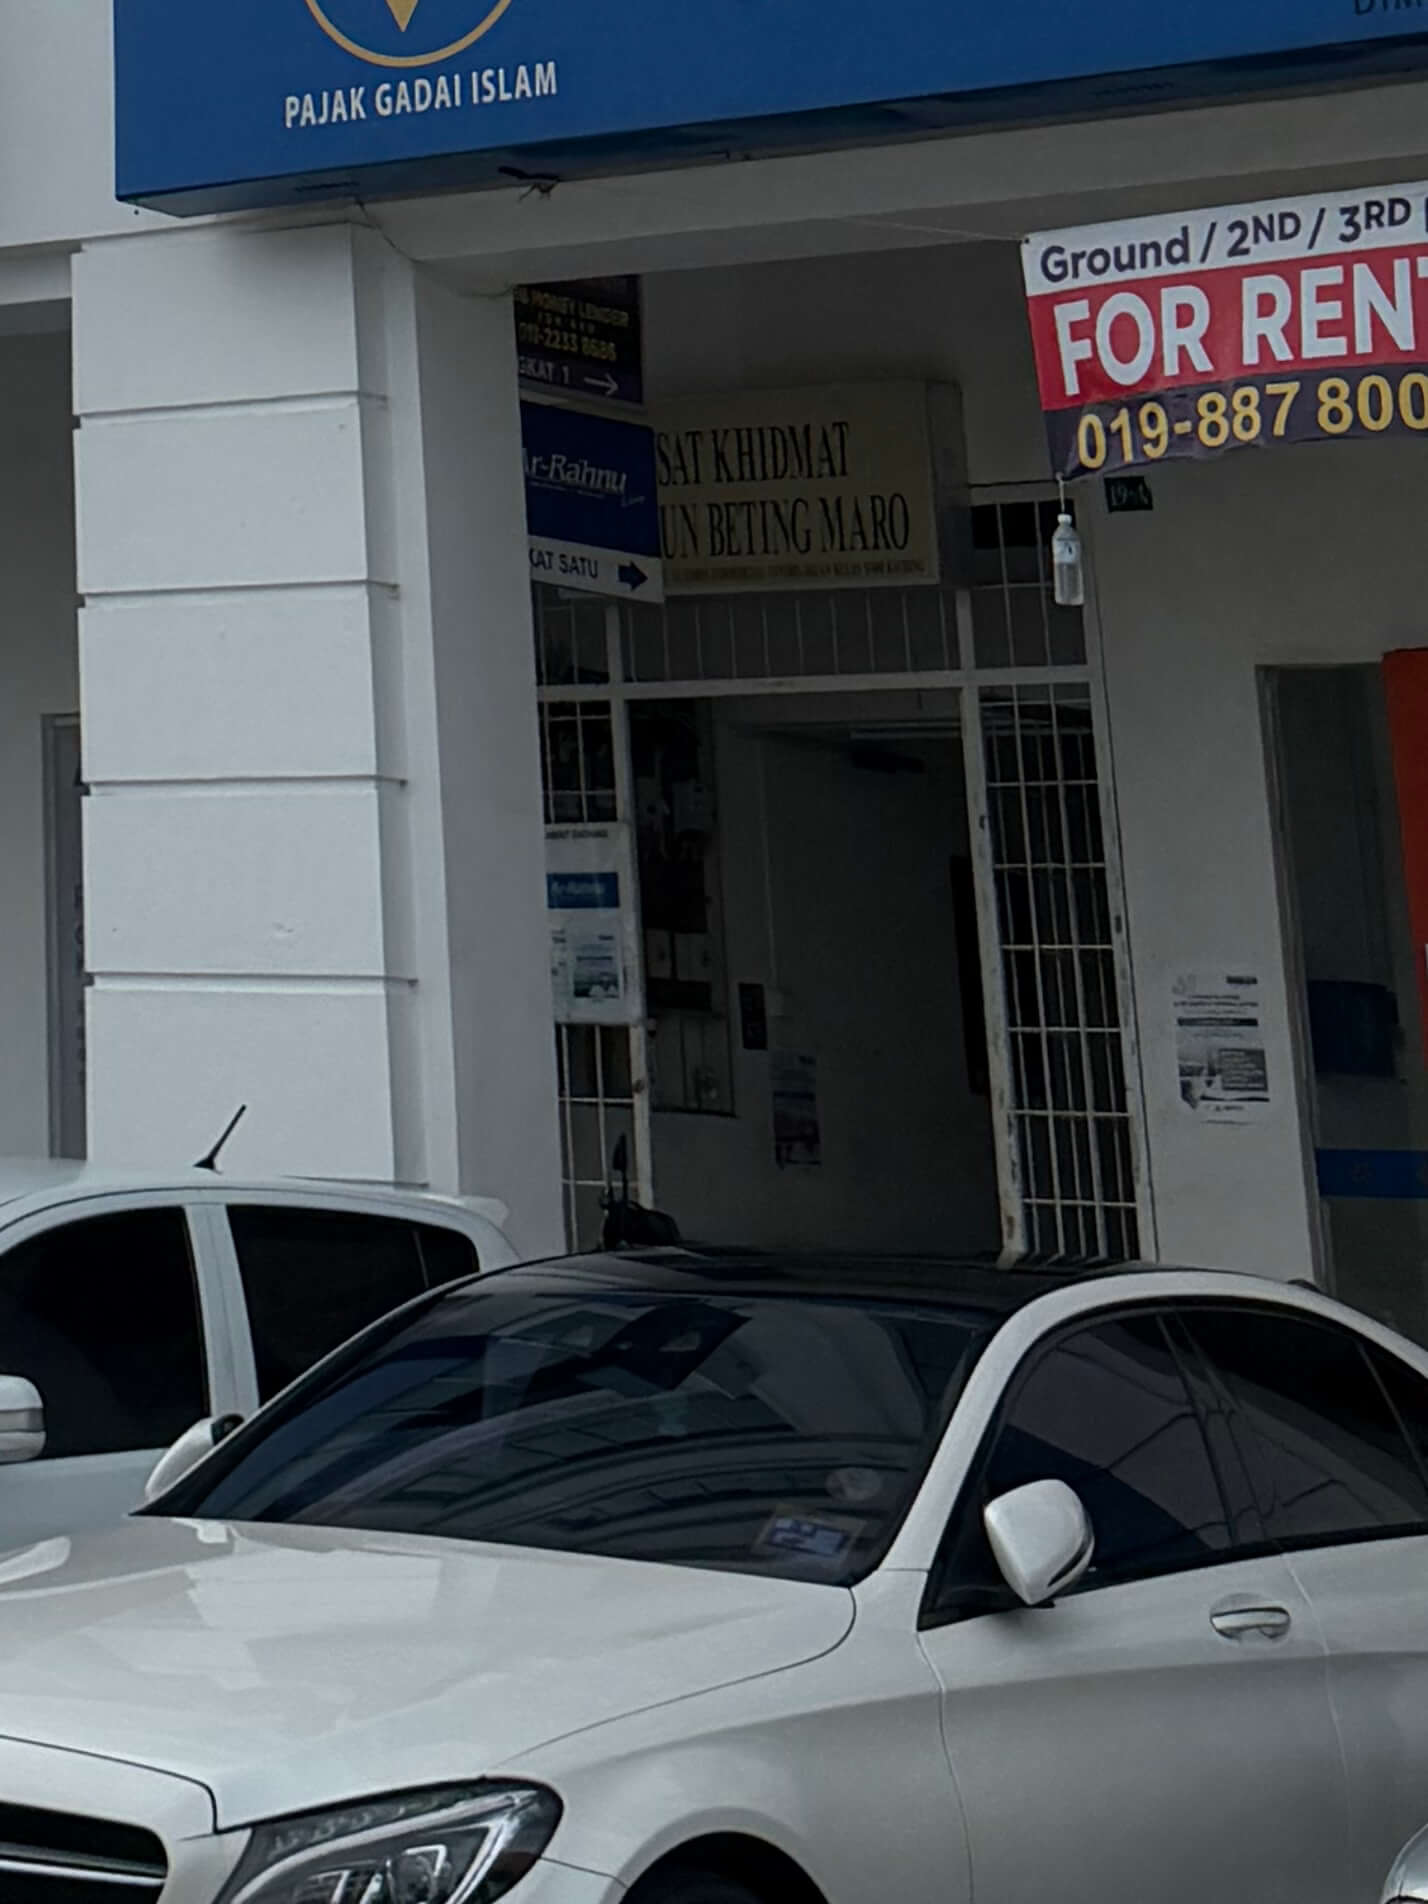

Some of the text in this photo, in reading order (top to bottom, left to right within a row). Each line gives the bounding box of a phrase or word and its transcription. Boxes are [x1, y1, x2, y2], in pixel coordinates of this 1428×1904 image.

[285, 60, 558, 128] PAJAK GADAI ISLAM
[1039, 197, 1412, 283] Ground / 2ND / 3RD
[1053, 256, 1428, 396] FOR REN
[657, 421, 849, 487] SAT KHIDMAT
[1077, 381, 1301, 469] 019-887
[707, 498, 812, 557] BETING
[819, 493, 910, 553] MARO
[559, 554, 599, 579] SATU
